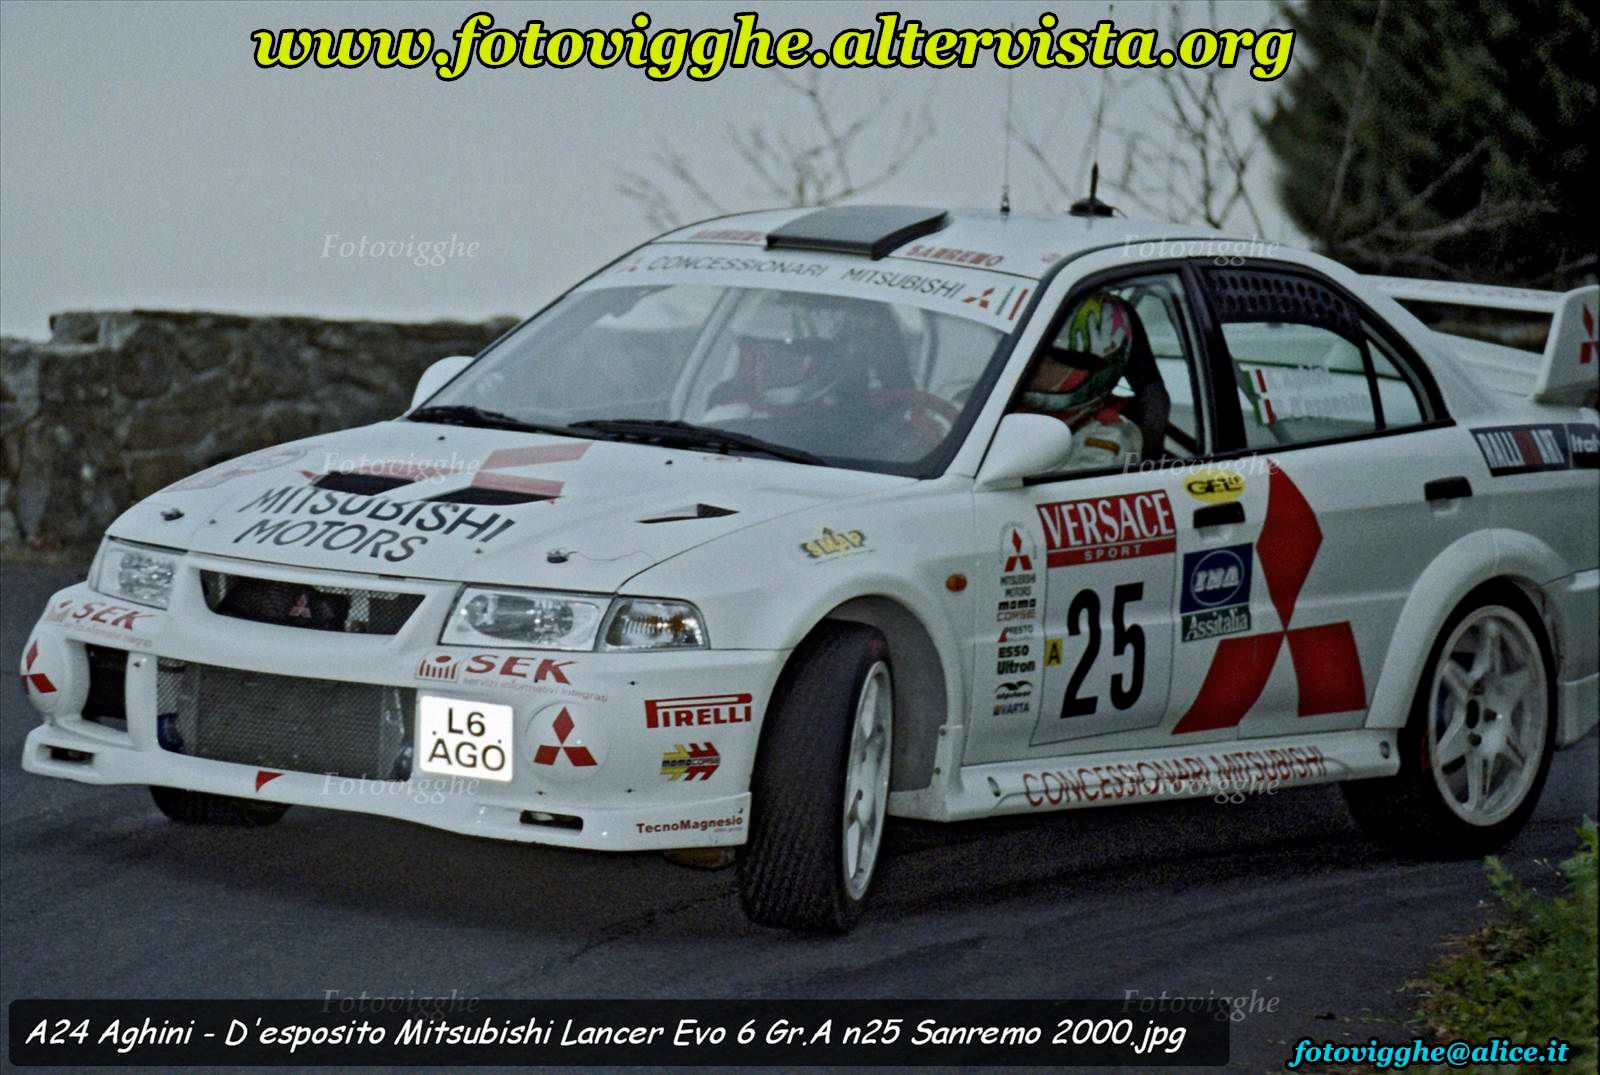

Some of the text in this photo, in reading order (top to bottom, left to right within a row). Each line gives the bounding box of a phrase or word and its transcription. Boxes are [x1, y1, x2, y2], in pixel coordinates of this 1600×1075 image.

[647, 255, 967, 299] CONCESSIONARI MITSUBISHI
[235, 483, 516, 544] MITSUBISHI
[1040, 493, 1176, 548] VERSACE
[233, 519, 429, 563] MOTORS
[1084, 544, 1143, 562] SPORT
[72, 602, 156, 631] SEK
[1184, 605, 1250, 641] Assitalia
[996, 659, 1036, 675] Ultron
[1047, 641, 1061, 668] A
[1060, 581, 1146, 719] 25
[465, 654, 578, 686] SEK
[447, 707, 487, 738] L6
[644, 693, 753, 729] PIRELLI
[427, 738, 506, 772] AGO
[1023, 744, 1328, 808] CONCESSIONARI MITSUBISHI
[636, 815, 744, 834] TecnoMagnesio
